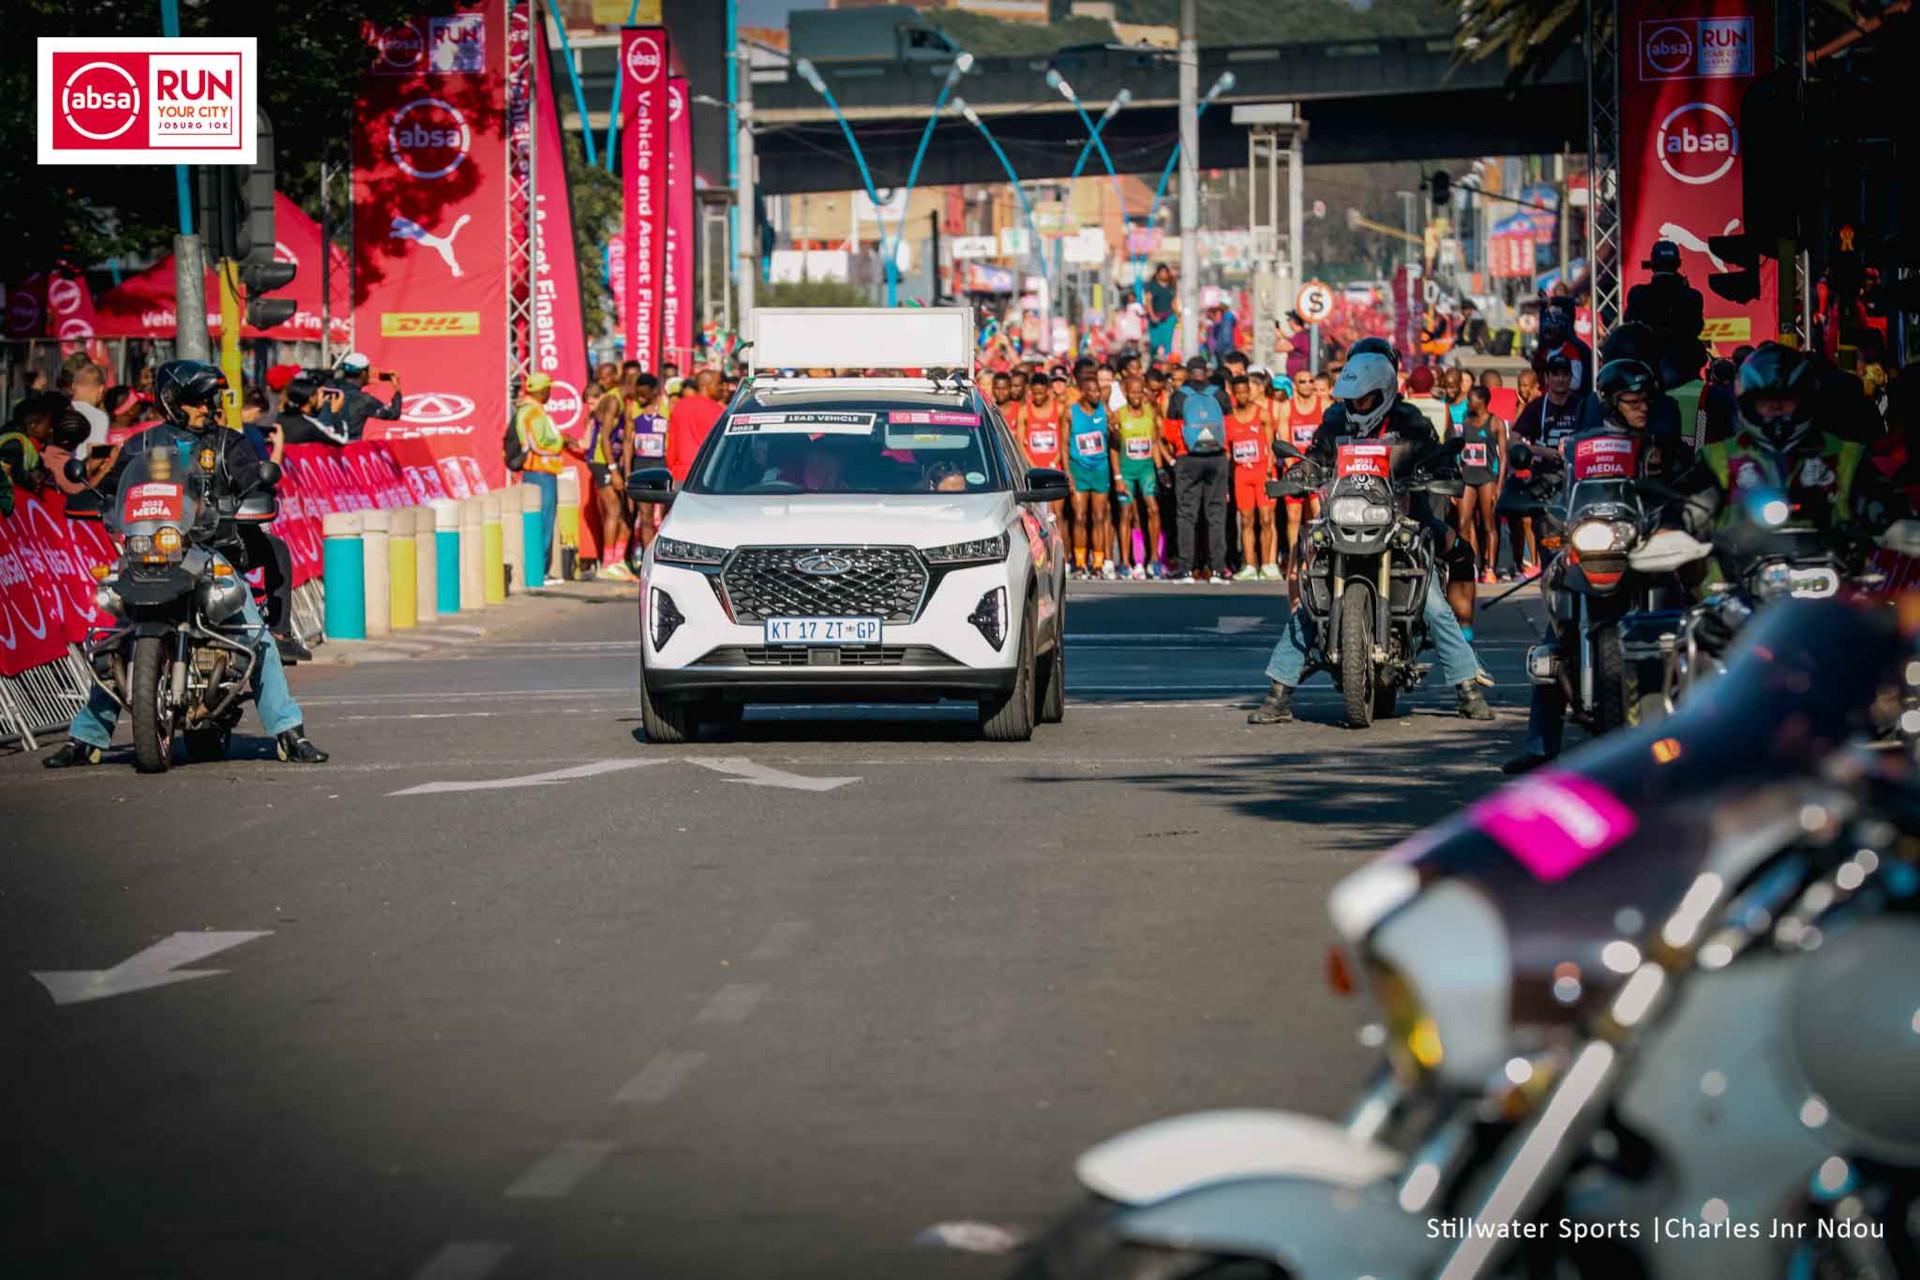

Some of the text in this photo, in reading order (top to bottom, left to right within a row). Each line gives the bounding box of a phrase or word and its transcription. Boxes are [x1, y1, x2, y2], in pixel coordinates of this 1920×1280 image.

[1702, 28, 1747, 48] RUN
[400, 122, 461, 148] absa
[638, 90, 653, 171] Vehicle
[1667, 127, 1729, 153] absa
[638, 174, 653, 217] and
[638, 220, 653, 285] Asset
[1308, 291, 1325, 314] S
[397, 317, 464, 332] DHL
[536, 278, 558, 371] Finance
[788, 414, 815, 422] LEAD
[817, 414, 860, 423] VEHICLE
[1345, 463, 1381, 473] MEDIA
[1586, 463, 1624, 475] MEDIA
[132, 506, 172, 519] MEDIA
[772, 621, 876, 640] KT 17 ZT GP
